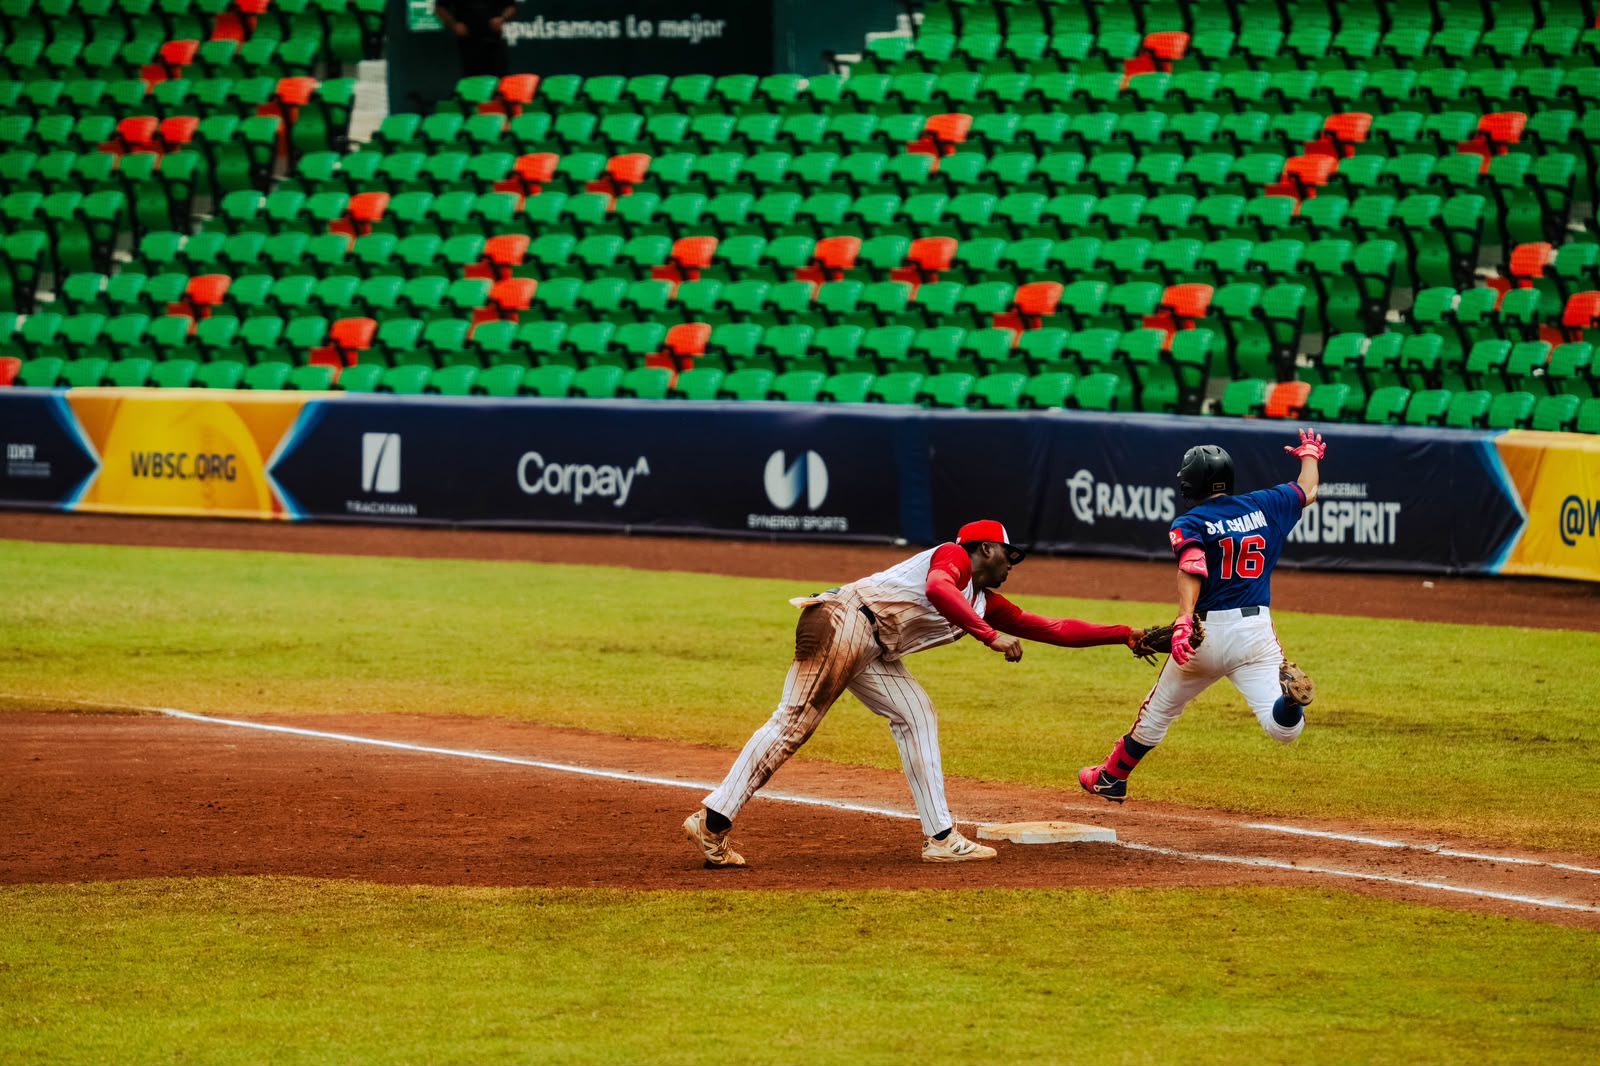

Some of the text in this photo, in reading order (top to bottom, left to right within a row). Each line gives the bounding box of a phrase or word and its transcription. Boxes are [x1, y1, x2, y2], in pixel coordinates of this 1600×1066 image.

[502, 15, 620, 46] pulsamos
[658, 13, 726, 44] mejor
[131, 450, 236, 482] WBSC.ORG
[517, 451, 636, 507] Corpay
[1096, 482, 1176, 522] RAXUS
[803, 516, 848, 531] SPORTS
[1322, 501, 1401, 545] SPIRIT
[1218, 534, 1266, 580] 16
